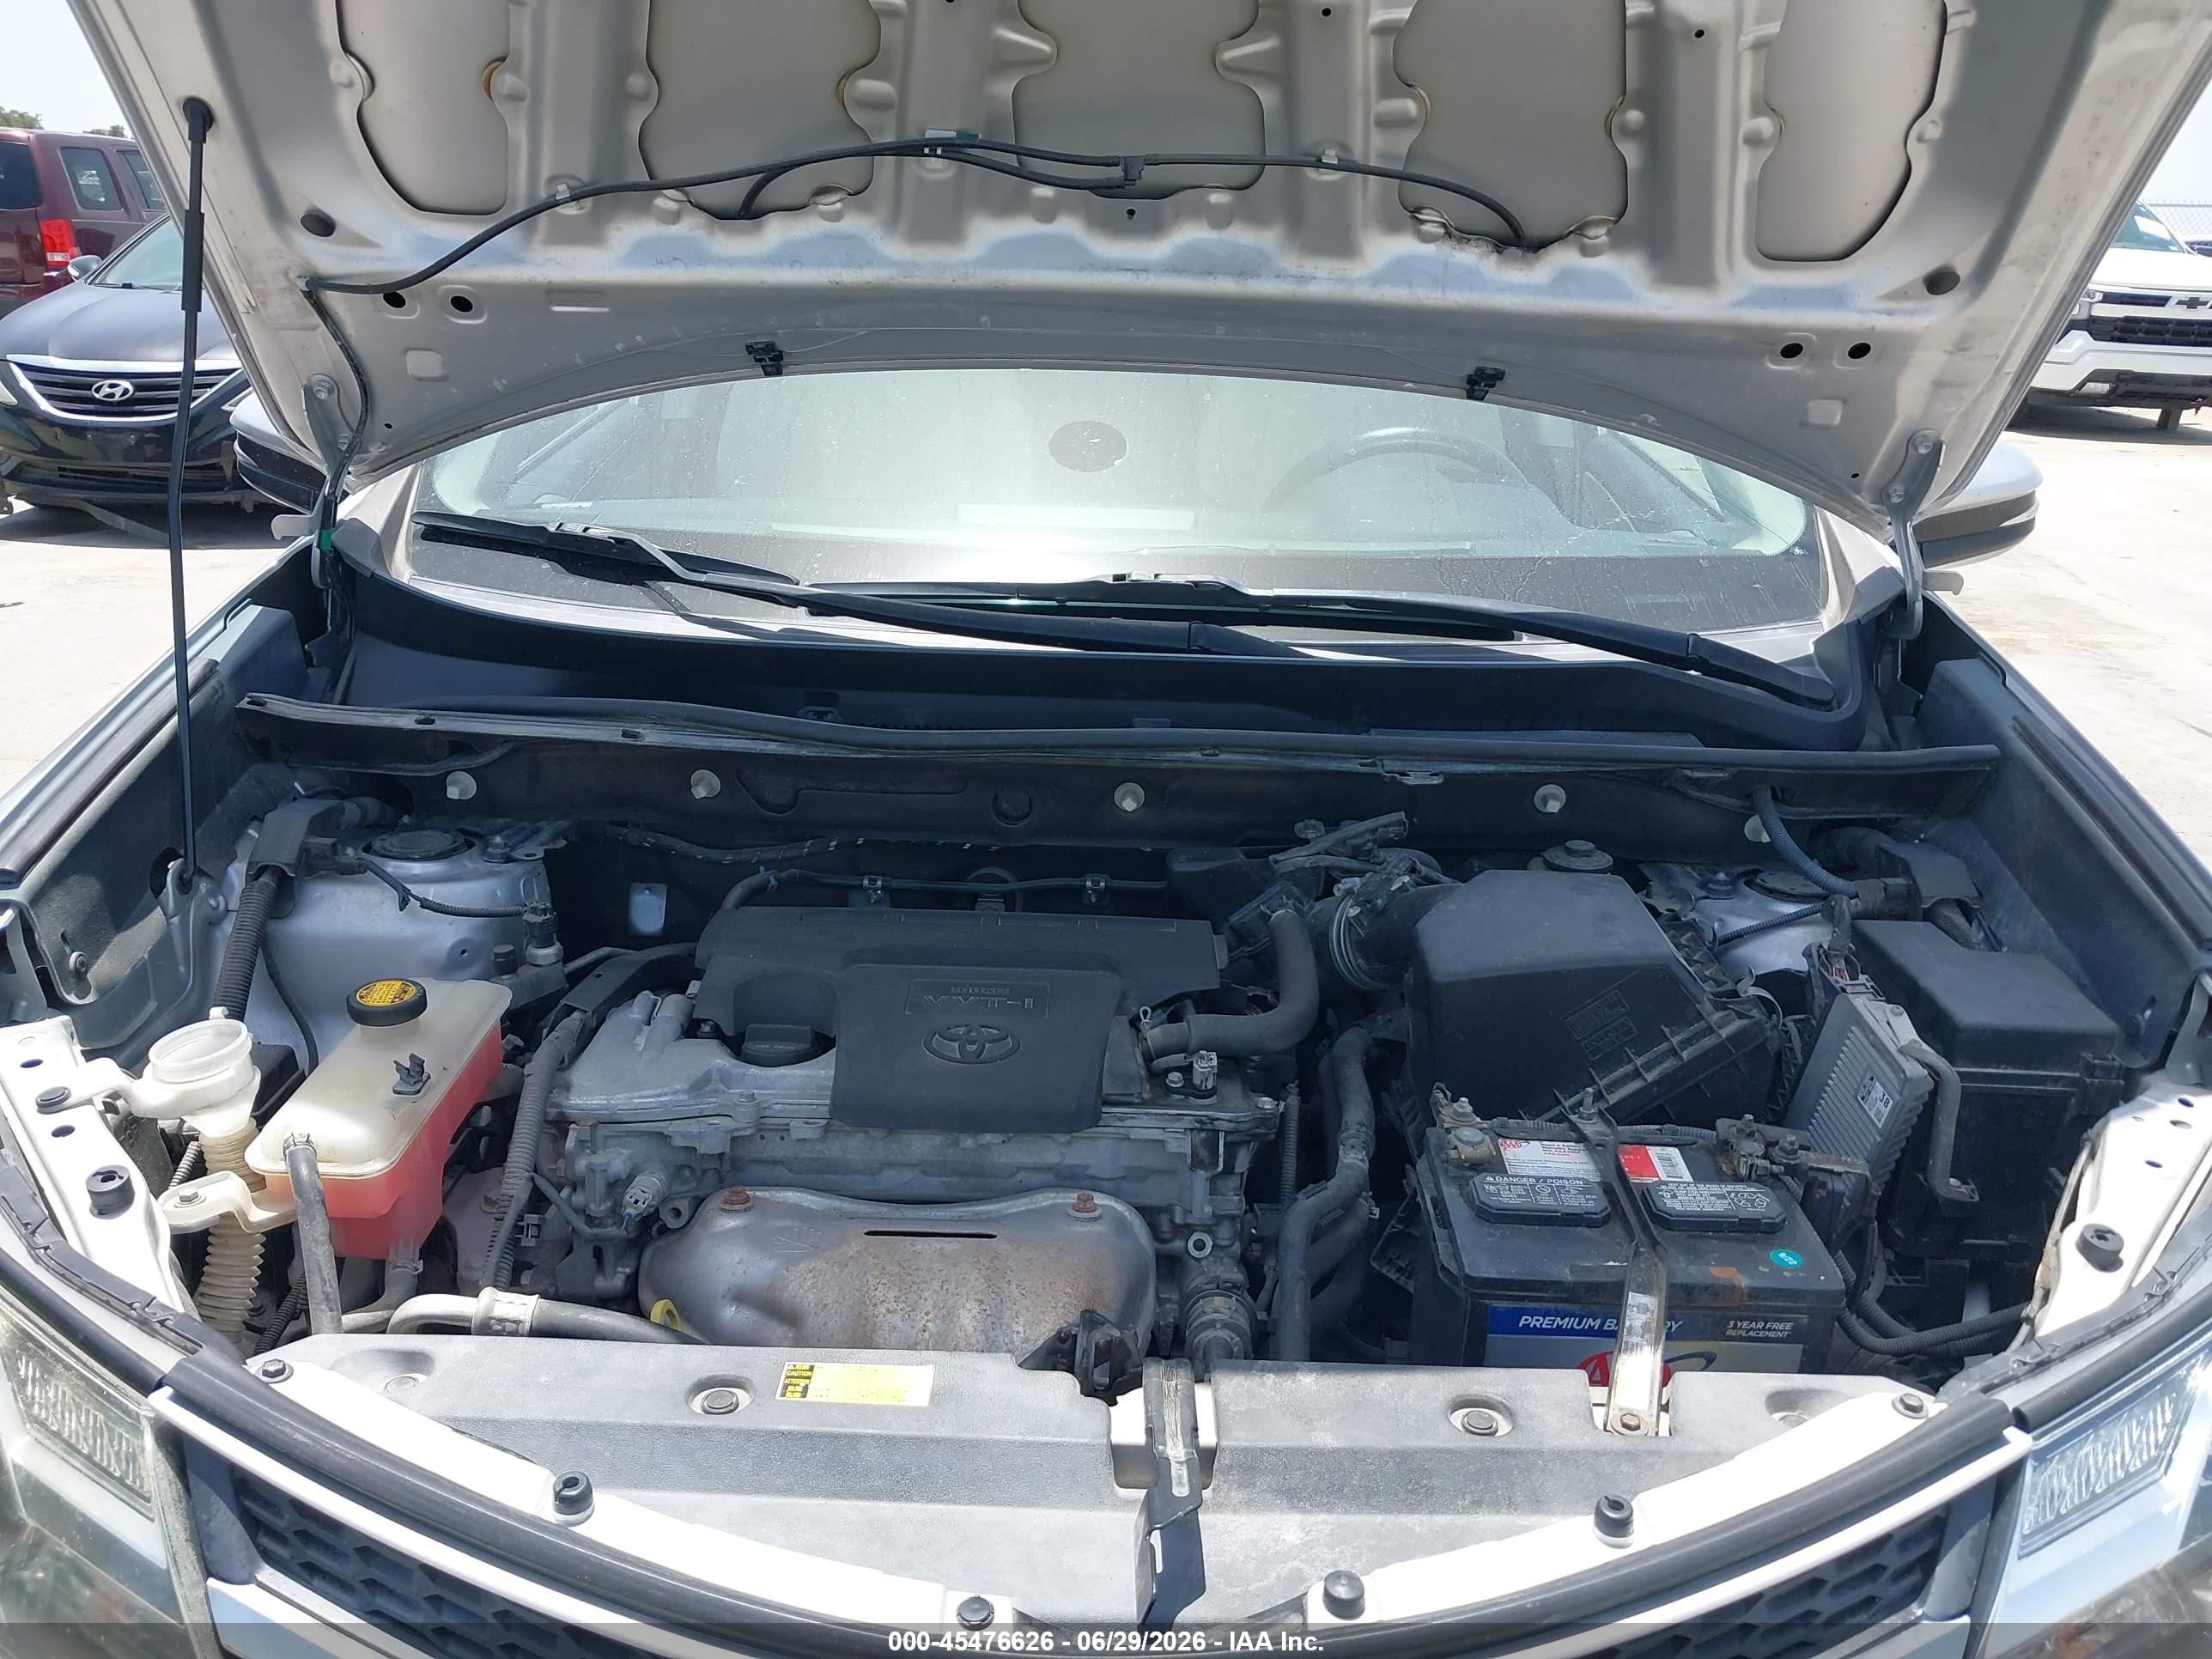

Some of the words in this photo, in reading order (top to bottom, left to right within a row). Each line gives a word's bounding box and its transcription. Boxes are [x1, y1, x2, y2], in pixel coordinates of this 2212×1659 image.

[1518, 1315, 1601, 1330] PREMIUM
[1727, 1320, 1735, 1328] 3
[1736, 1321, 1764, 1329] YEAR
[1765, 1322, 1794, 1330] FREE
[1725, 1329, 1788, 1338] REPLACEMENT
